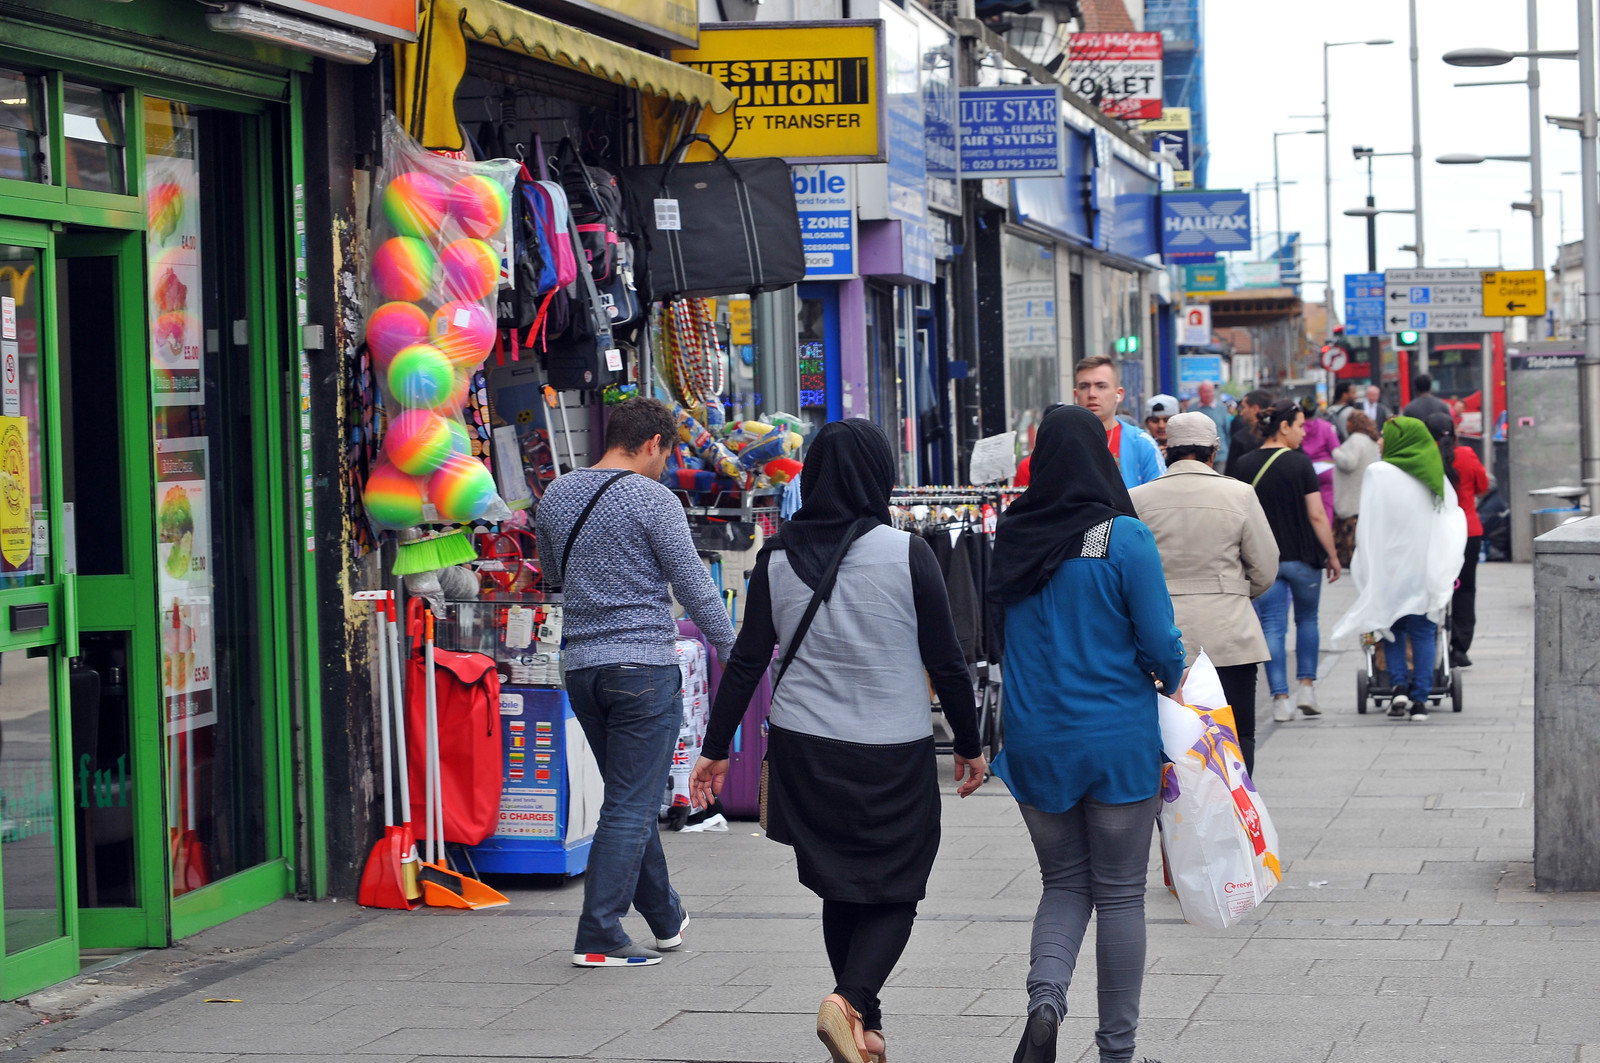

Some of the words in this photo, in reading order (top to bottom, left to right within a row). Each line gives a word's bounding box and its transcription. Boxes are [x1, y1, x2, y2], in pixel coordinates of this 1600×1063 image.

[1108, 77, 1154, 95] LET
[729, 84, 834, 106] UNION
[961, 101, 998, 123] LUE
[1003, 99, 1055, 122] STAR
[736, 116, 754, 130] EY
[764, 113, 861, 130] TRANSFER
[961, 135, 989, 146] AIR
[993, 134, 1054, 146] STYLIST
[972, 160, 994, 170] 020
[997, 159, 1025, 169] 8795
[1029, 159, 1056, 169] 1739
[793, 169, 846, 195] bile
[795, 197, 814, 205] orld
[807, 217, 850, 230] ZONE
[1165, 214, 1249, 232] HALIFAX
[803, 243, 851, 251] CCESSORIES
[805, 253, 830, 266] hone
[1501, 277, 1537, 286] Regent
[1500, 288, 1538, 297] College
[799, 343, 824, 359] ONE
[799, 360, 824, 375] ING
[1526, 356, 1577, 370] Telephone
[801, 374, 824, 390] RS
[79, 753, 128, 809] ful
[499, 812, 507, 821] G
[509, 812, 555, 822] CHARGES
